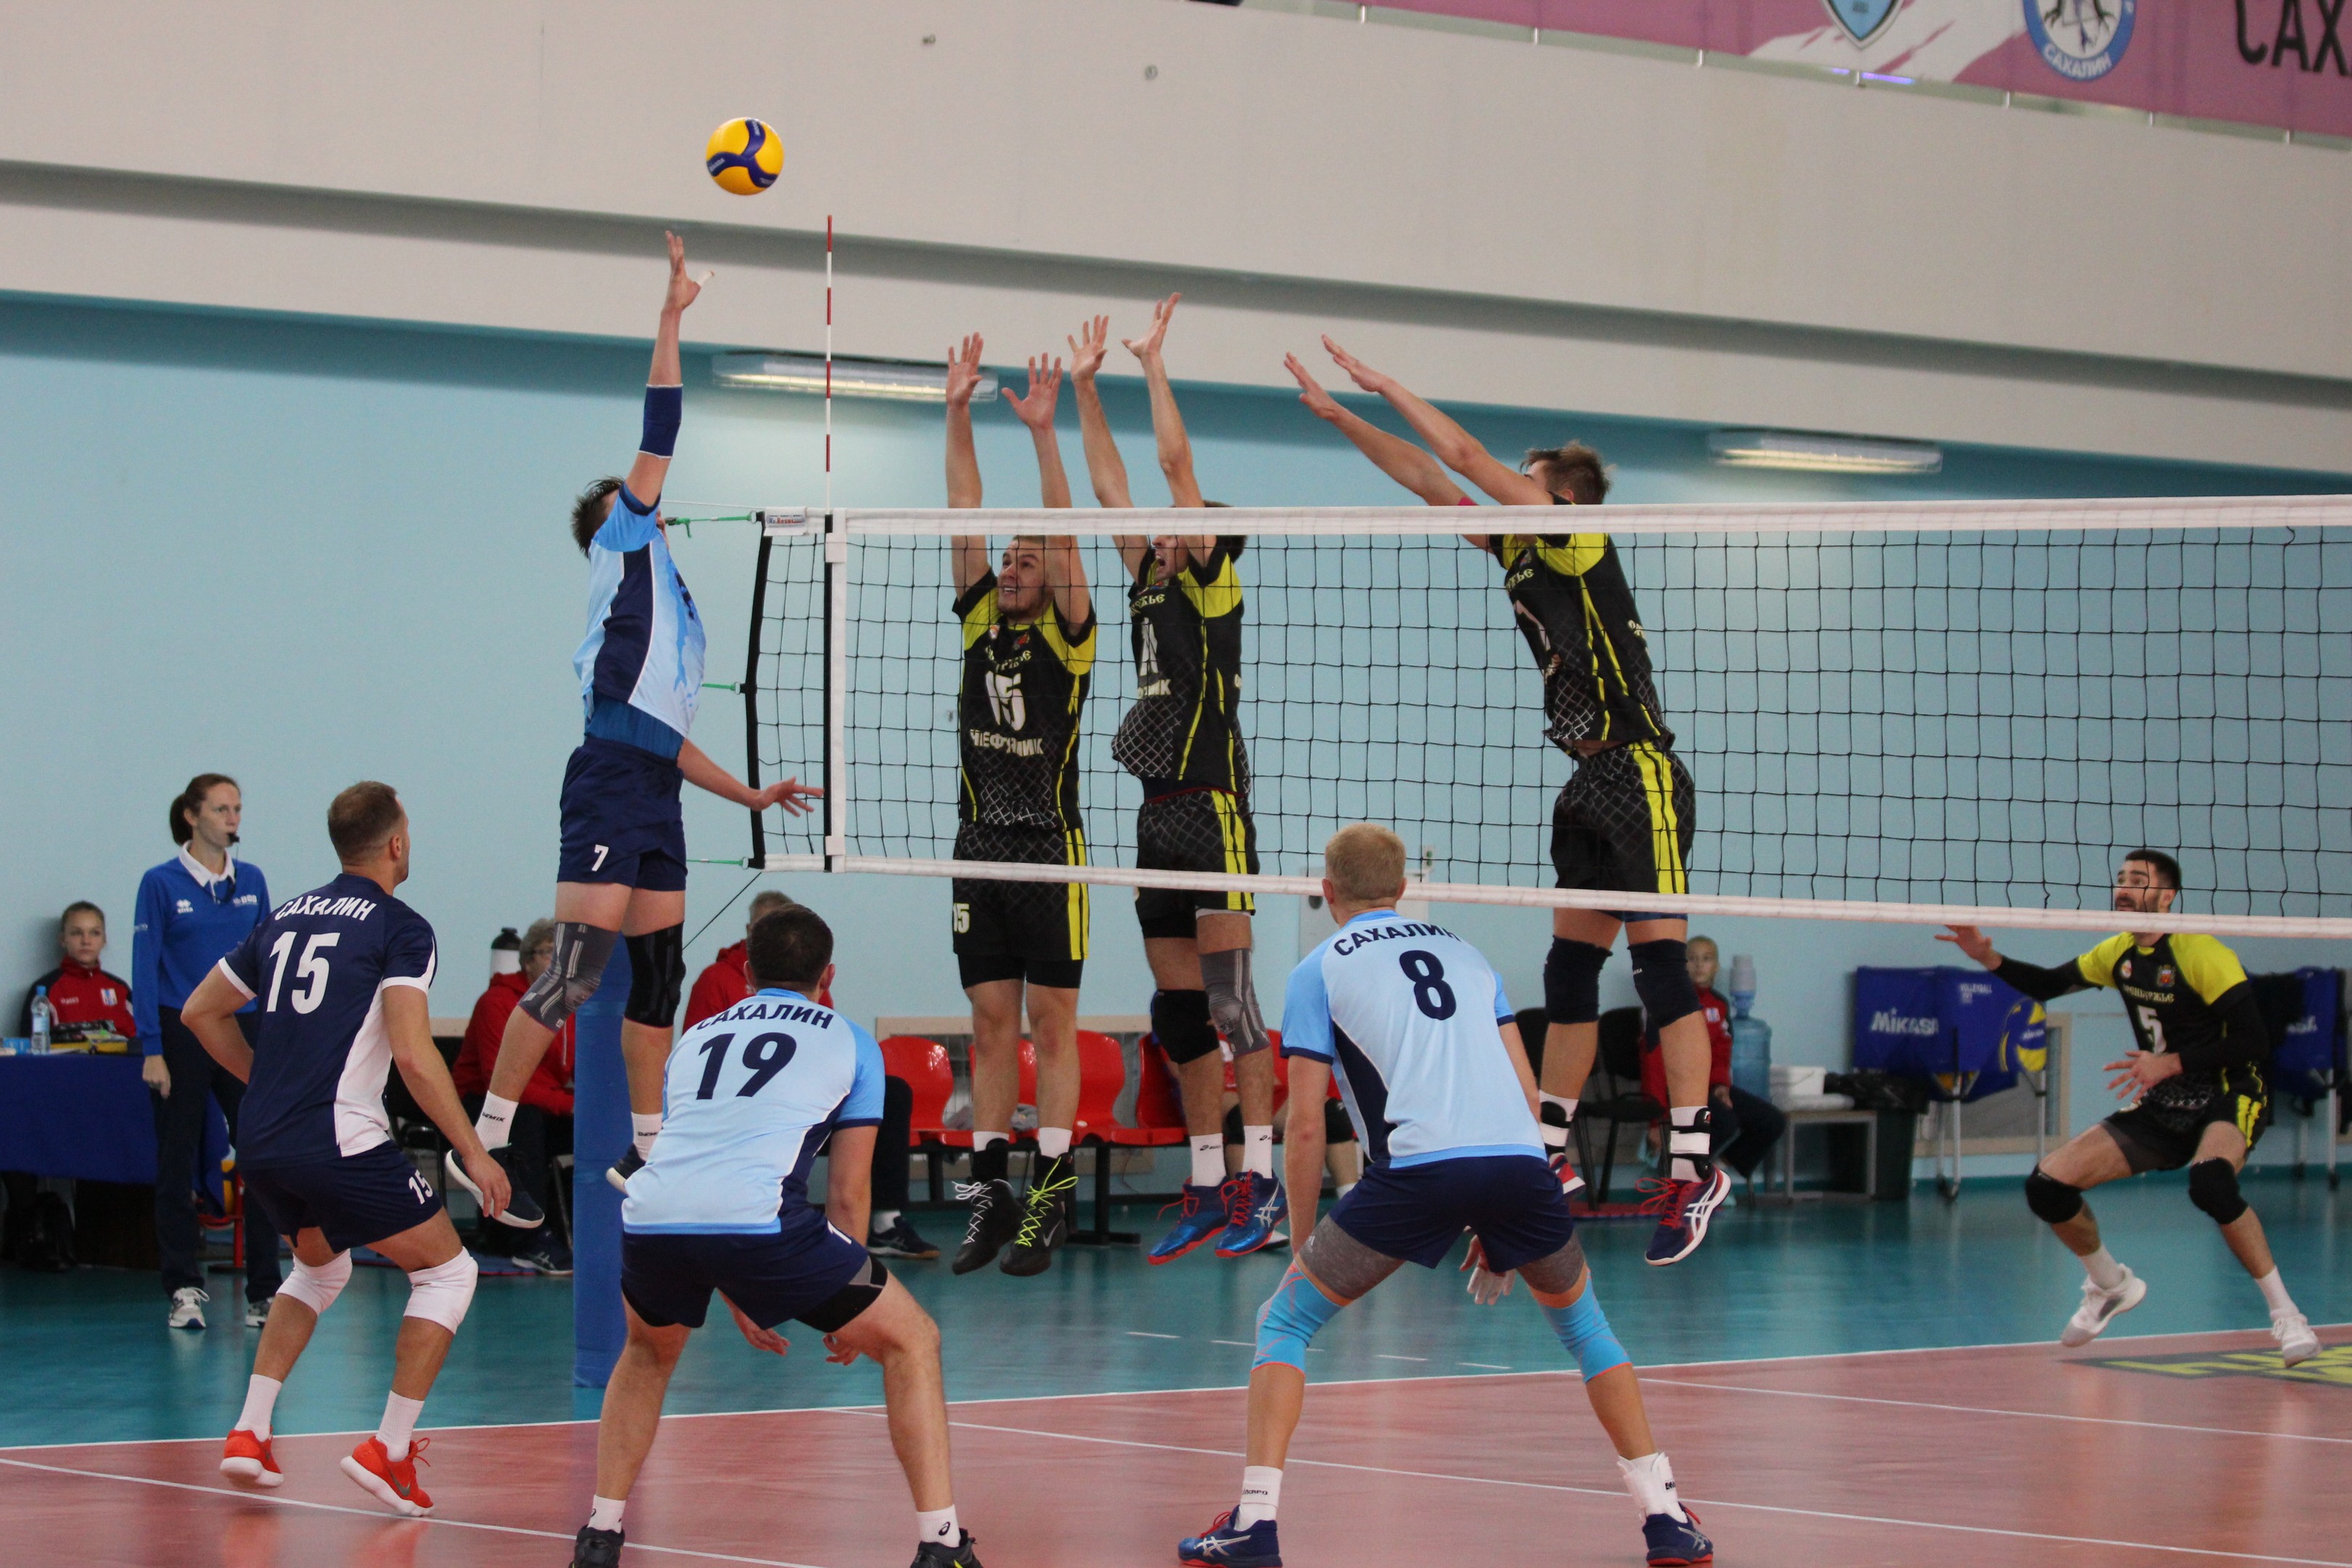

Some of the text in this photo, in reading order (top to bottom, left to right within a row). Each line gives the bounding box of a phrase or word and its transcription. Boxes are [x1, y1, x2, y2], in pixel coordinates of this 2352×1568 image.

[985, 670, 1026, 732] 15
[591, 844, 609, 872] 7
[274, 895, 377, 921] САХАЛИН
[953, 902, 970, 934] 15
[266, 931, 340, 1015] 15
[1399, 950, 1457, 1021] 8
[696, 1004, 834, 1030] САХАЛИН
[2137, 1005, 2167, 1055] 5
[696, 1032, 797, 1101] 19
[409, 1169, 433, 1205] 15
